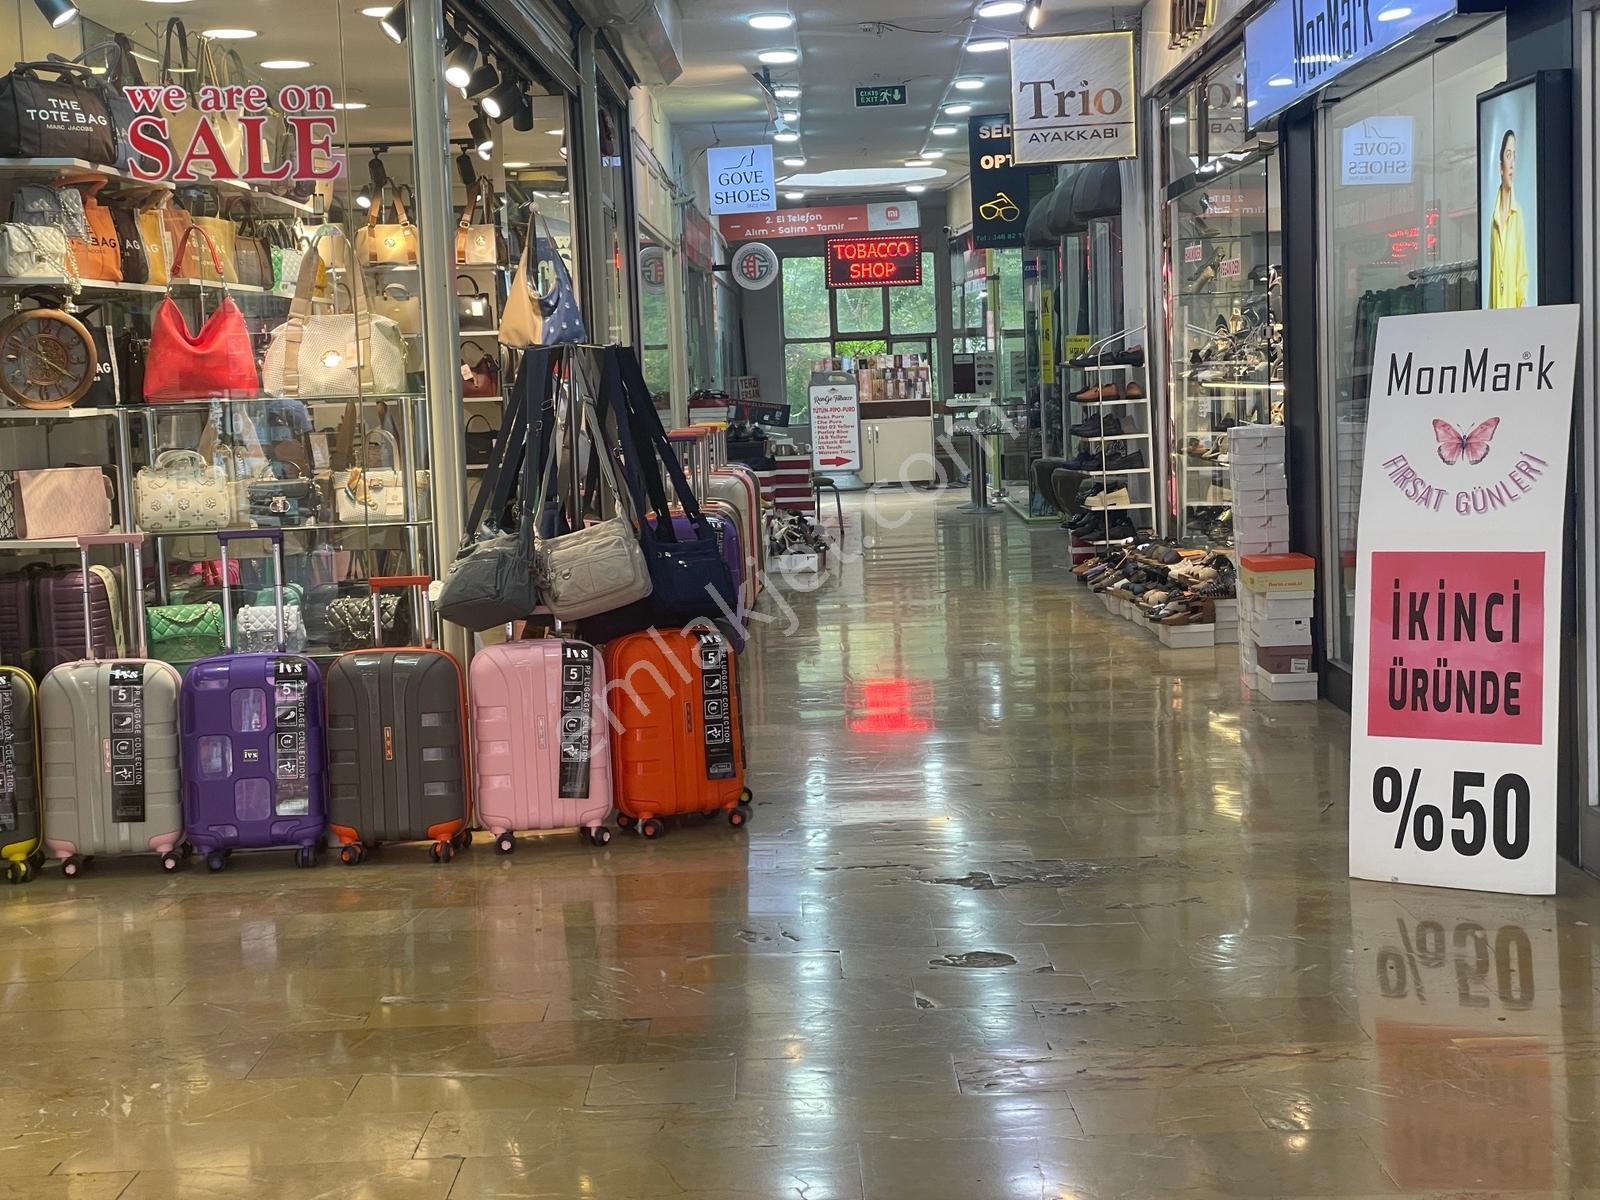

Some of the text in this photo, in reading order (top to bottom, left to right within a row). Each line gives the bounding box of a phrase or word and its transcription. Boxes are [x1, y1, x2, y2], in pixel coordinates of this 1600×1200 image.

[1293, 0, 1373, 88] MonMark
[48, 98, 80, 110] THE
[123, 85, 335, 113] we are on
[1019, 79, 1122, 119] Trio
[26, 109, 107, 126] TOTE BAG
[1028, 128, 1118, 143] AYAKKABI
[127, 115, 342, 182] SALE
[718, 171, 764, 186] GOVE
[714, 188, 770, 205] SHOES
[787, 212, 822, 222] Telefon
[833, 242, 911, 260] TOBACCO
[850, 263, 897, 278] SHOP
[1387, 345, 1555, 396] MonMark
[1381, 451, 1549, 515] FIRSAT GÜNLERİ
[1391, 578, 1521, 643] İKİNCİ
[707, 652, 715, 664] 5
[569, 668, 578, 680] 5
[1388, 656, 1521, 715] ÜRÜNDE
[118, 688, 127, 701] 5
[282, 683, 291, 695] 5
[583, 677, 591, 713] LUGGAGE
[134, 698, 142, 734] LUGGAGE
[722, 697, 730, 743] COLLECTION
[1372, 765, 1531, 860] %50
